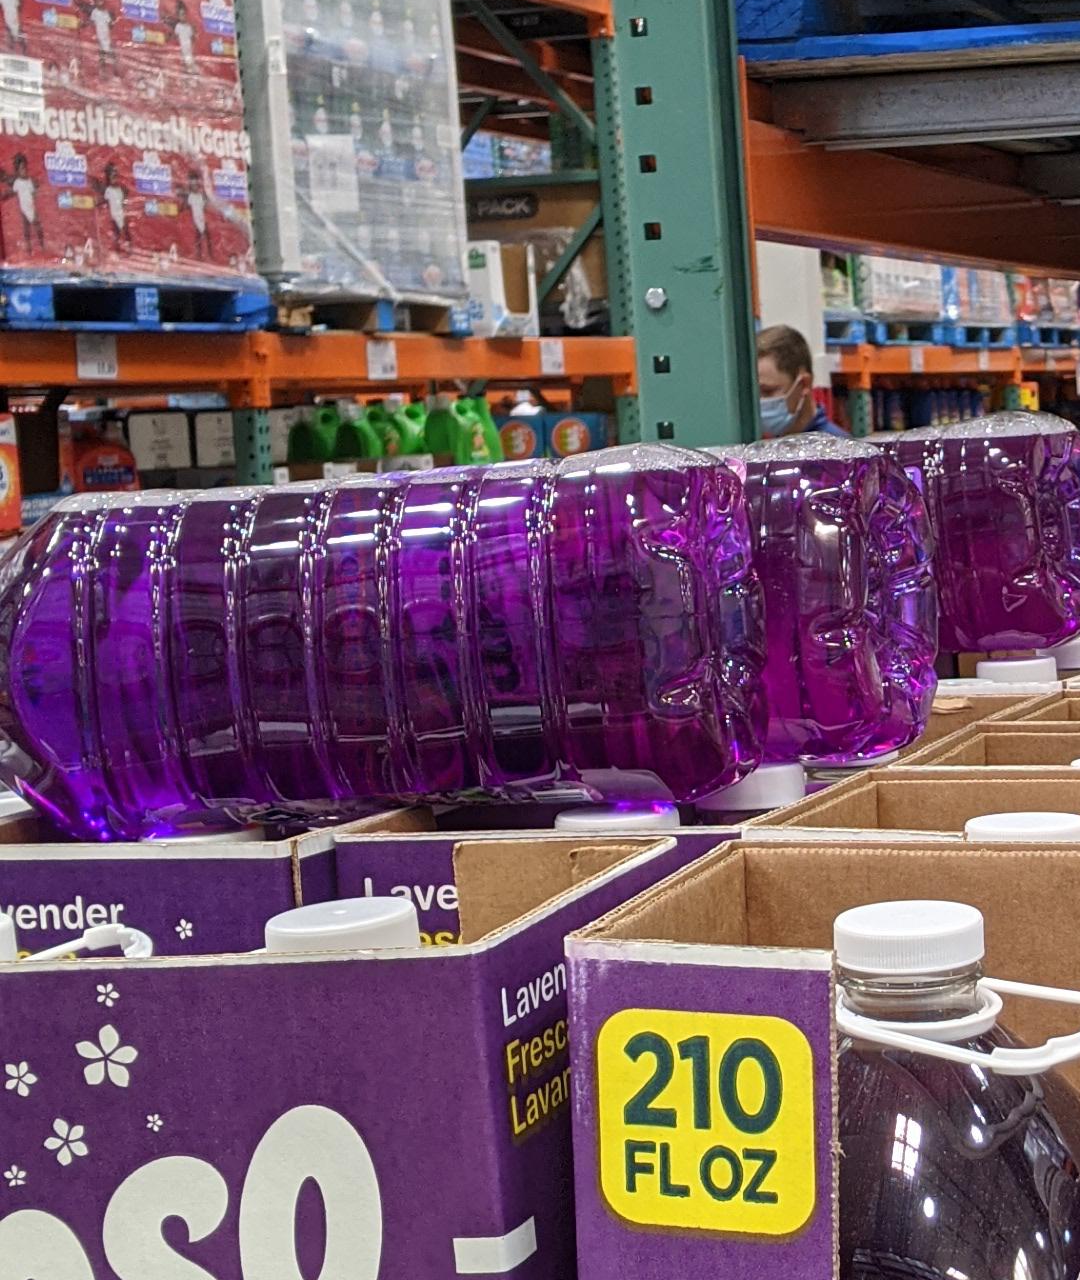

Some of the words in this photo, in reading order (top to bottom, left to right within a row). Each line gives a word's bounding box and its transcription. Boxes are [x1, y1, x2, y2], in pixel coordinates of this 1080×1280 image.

[506, 1017, 569, 1084] Fresc
[624, 1031, 783, 1135] 210
[625, 1139, 691, 1198] FL
[700, 1145, 778, 1204] OZ
